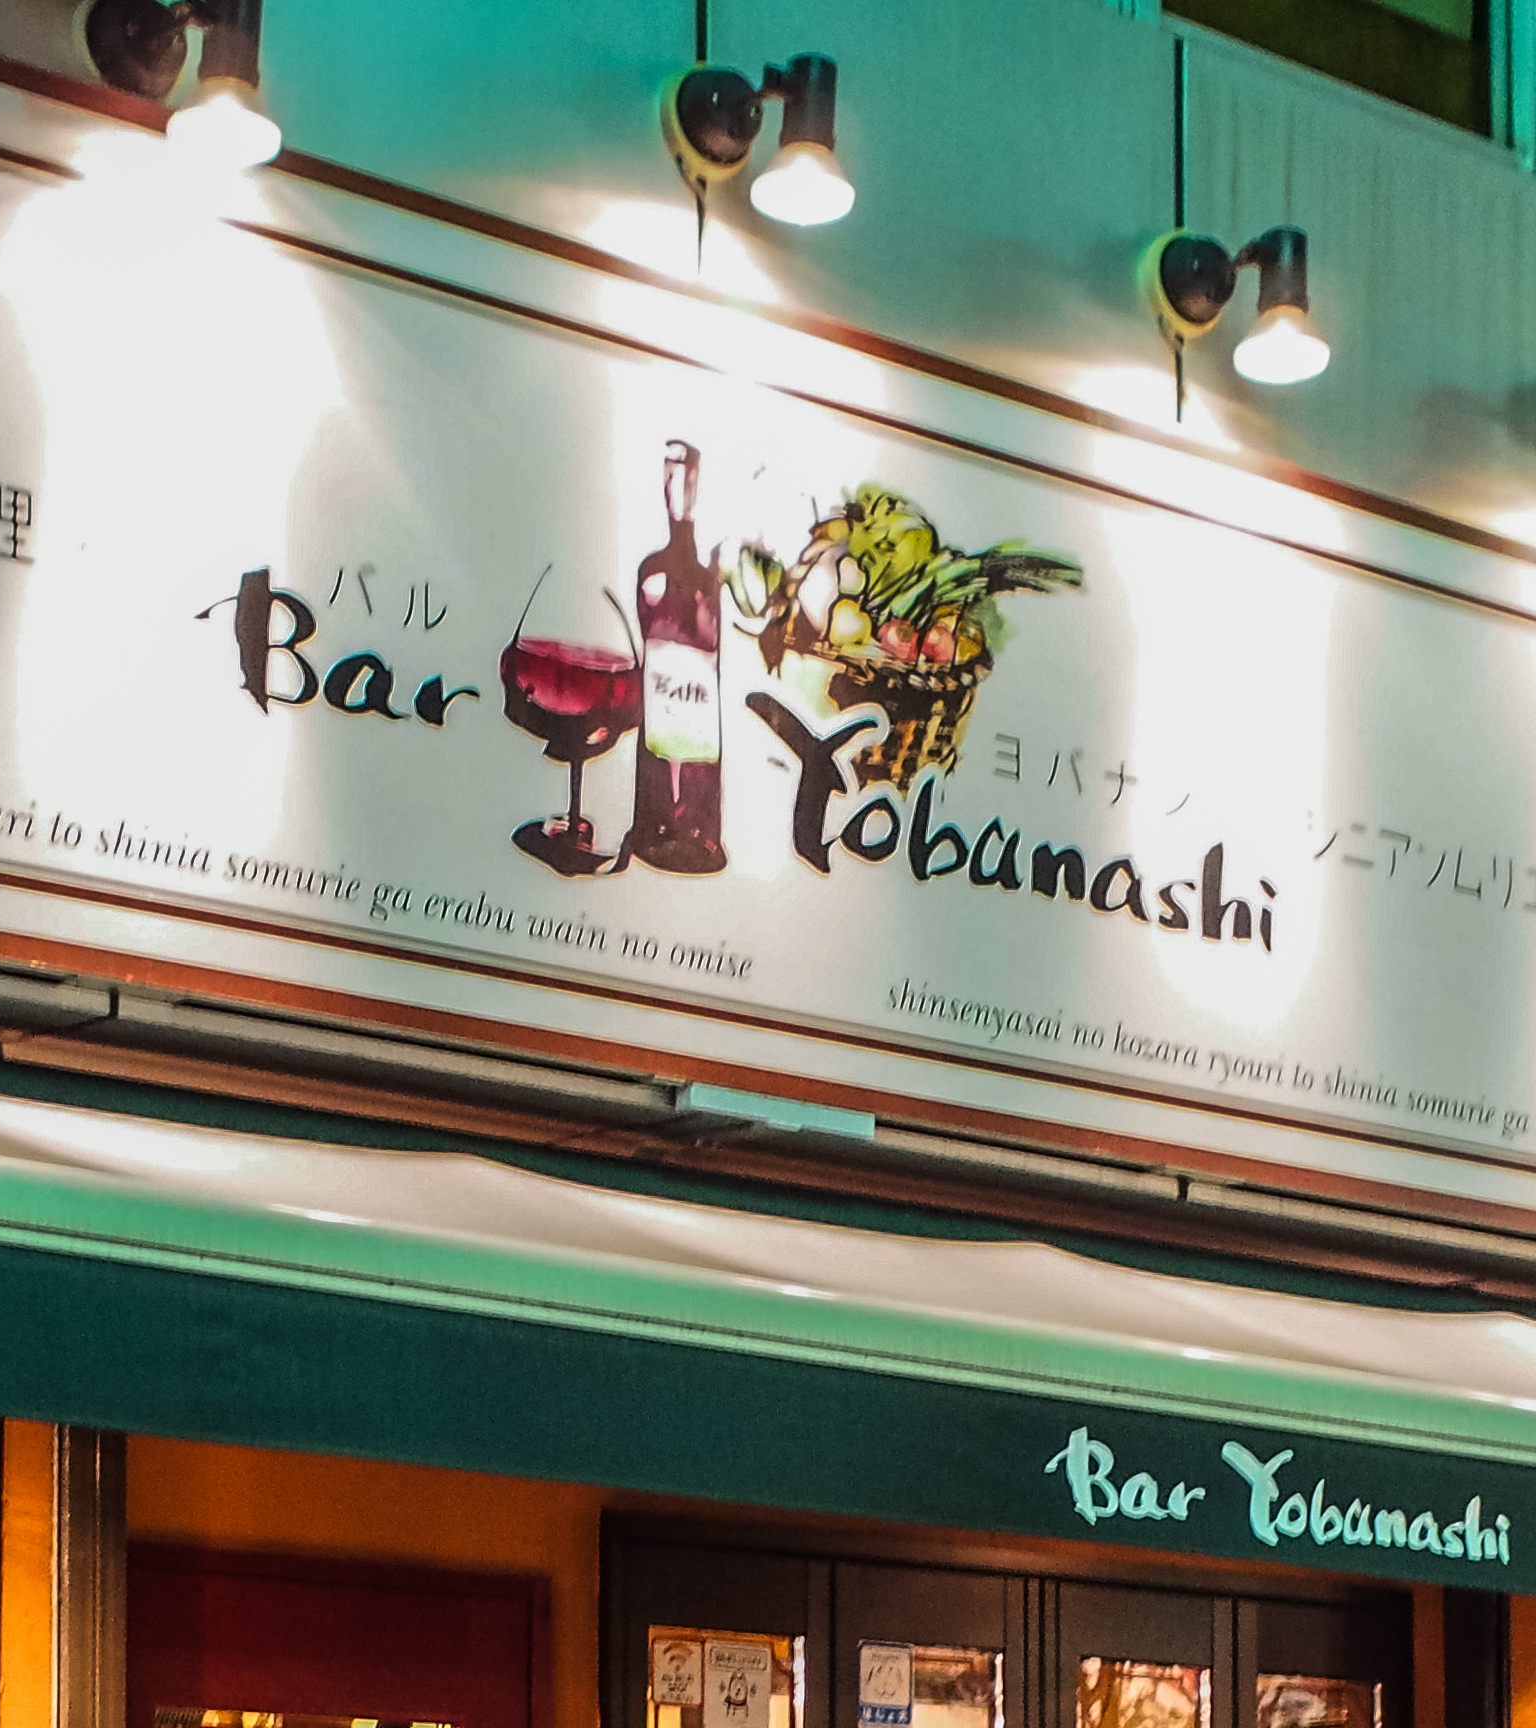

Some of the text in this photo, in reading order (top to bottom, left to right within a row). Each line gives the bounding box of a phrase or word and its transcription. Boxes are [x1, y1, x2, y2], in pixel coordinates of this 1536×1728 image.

[194, 566, 480, 725] Bar
[48, 812, 82, 851] to
[95, 823, 212, 876] shinia
[223, 851, 361, 904] somurie
[370, 883, 412, 922] ga
[423, 888, 516, 936] erabu
[526, 911, 607, 953] wain
[620, 932, 660, 962] no
[669, 941, 754, 980] omise
[743, 692, 1278, 950] Yobanashi
[888, 977, 1062, 1042] shinsenyasai
[1072, 1021, 1104, 1051] no
[1113, 1022, 1199, 1069] kozara
[1209, 1048, 1285, 1086] ryouri
[1292, 1062, 1315, 1091] to
[1325, 1065, 1398, 1108] shinia
[1501, 1108, 1529, 1141] ga
[1043, 1426, 1511, 1565] Bar Yobanashi
